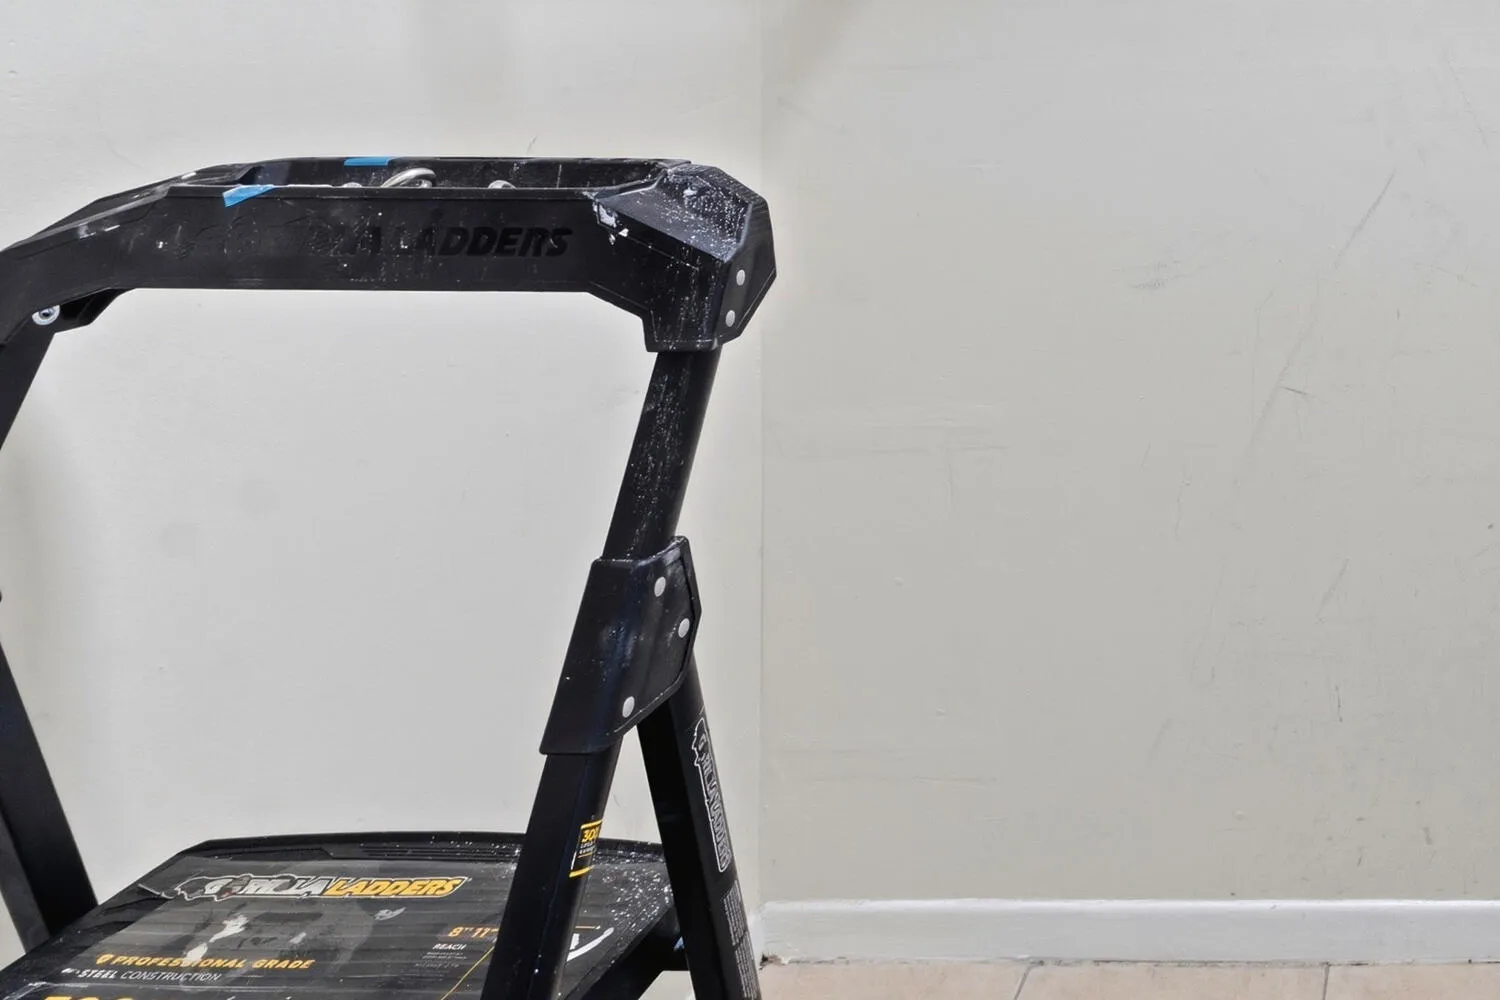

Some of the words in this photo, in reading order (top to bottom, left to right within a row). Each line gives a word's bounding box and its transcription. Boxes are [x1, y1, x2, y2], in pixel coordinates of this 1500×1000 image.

[322, 878, 463, 897] LADDERS
[432, 943, 468, 951] REACH
[251, 959, 316, 970] GRADE
[77, 968, 119, 979] STEEL
[119, 970, 223, 982] CONSTRUCTION
